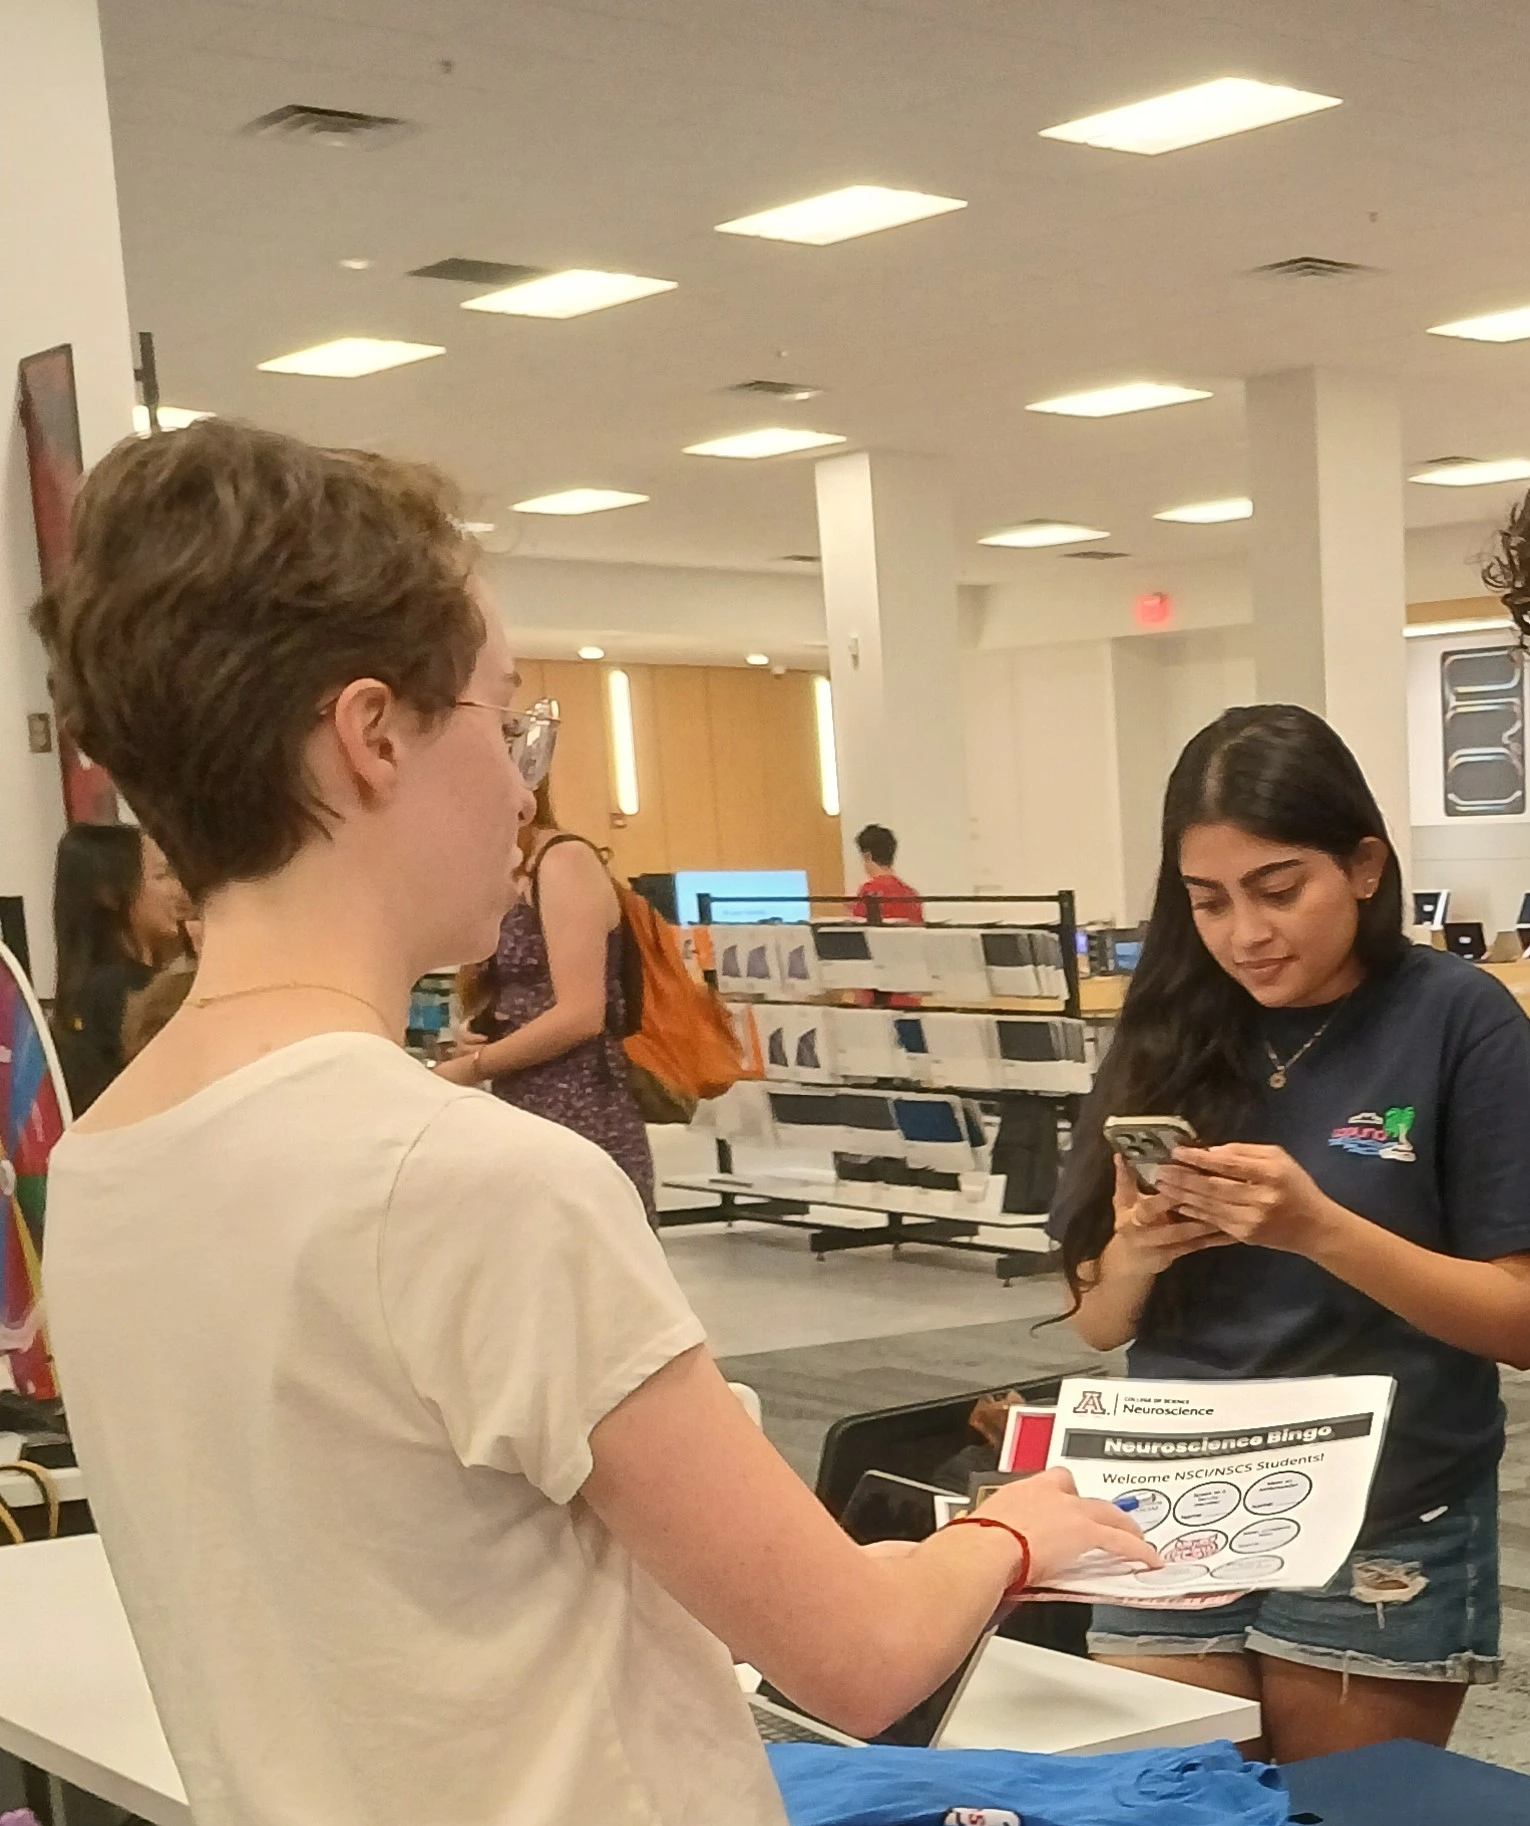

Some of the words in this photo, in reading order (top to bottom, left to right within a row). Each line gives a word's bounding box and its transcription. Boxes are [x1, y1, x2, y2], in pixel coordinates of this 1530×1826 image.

[1073, 1391, 1106, 1415] A
[1122, 1404, 1214, 1416] Neuroscience
[1104, 1434, 1263, 1458] Neuroscience
[1267, 1424, 1333, 1446] Bingo
[1103, 1471, 1170, 1485] Welcome
[1174, 1462, 1253, 1481] NSCI/NSCS
[1257, 1452, 1325, 1471] Students!
